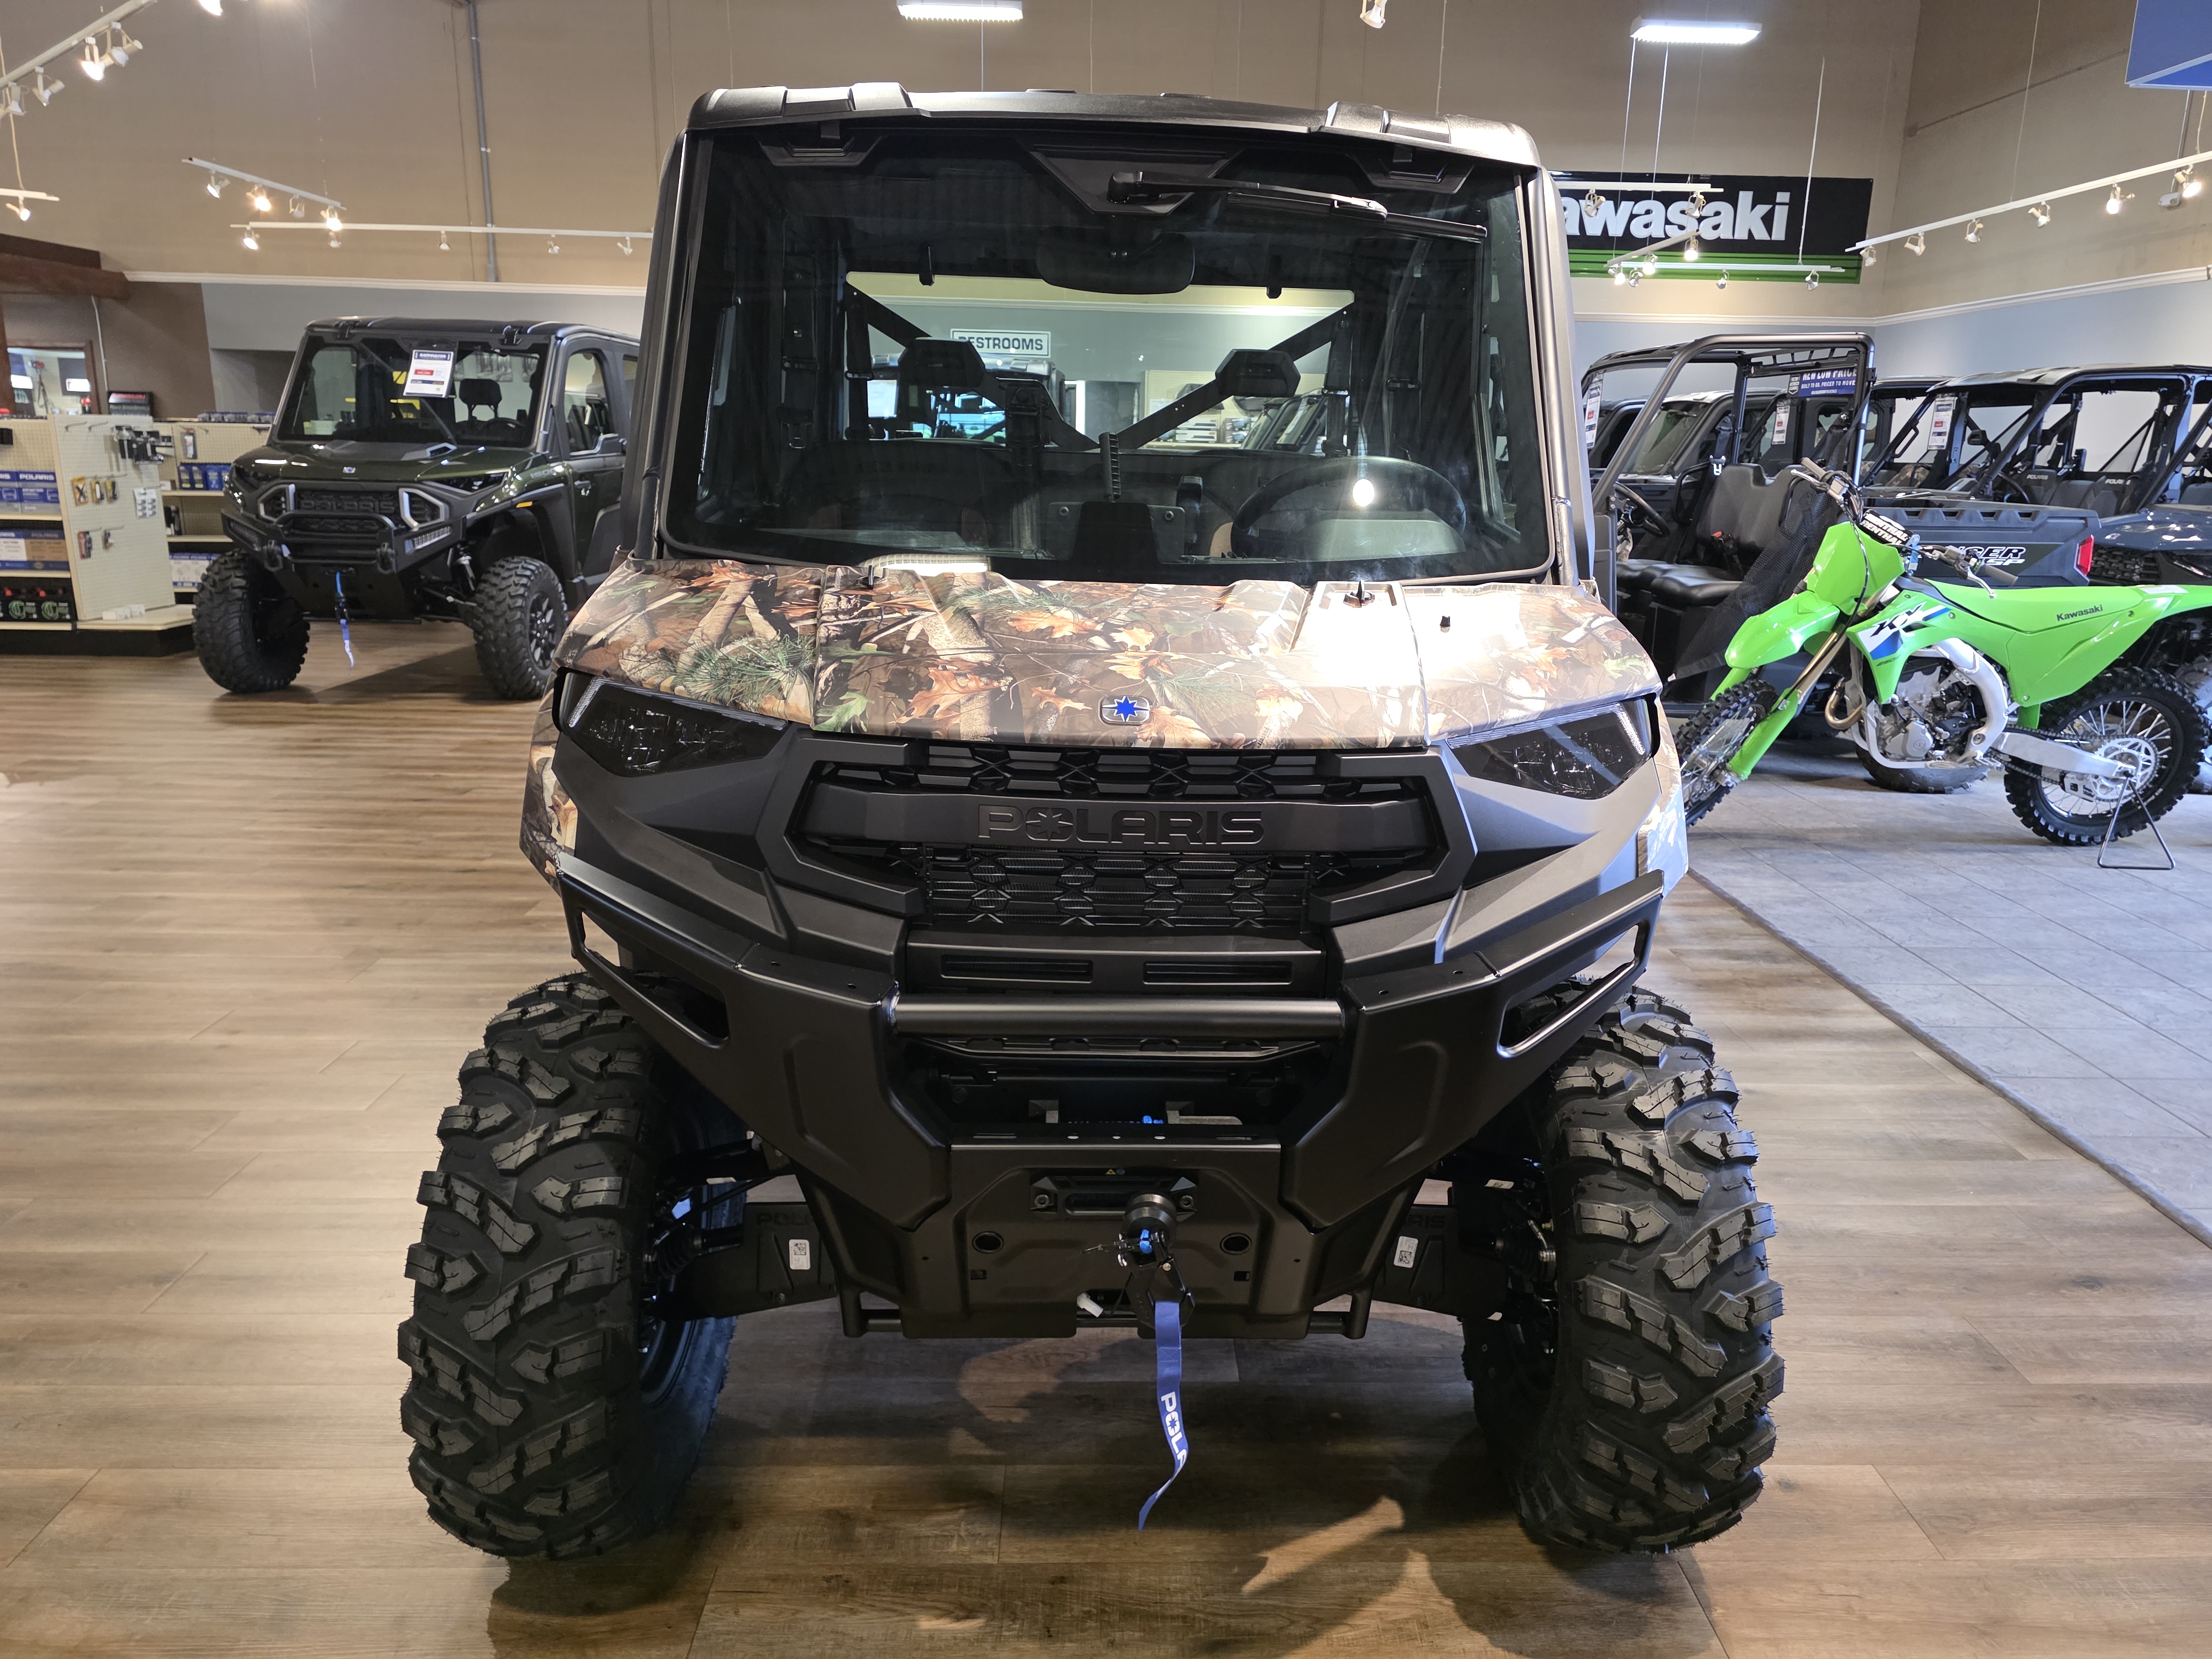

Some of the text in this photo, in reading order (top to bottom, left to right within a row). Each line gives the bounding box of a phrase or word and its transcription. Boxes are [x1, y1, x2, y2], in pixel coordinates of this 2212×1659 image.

[1561, 191, 1791, 241] awasaki
[300, 500, 395, 513] POLARIS
[2056, 604, 2103, 622] Kawasaki
[978, 804, 1264, 844] POLARIS
